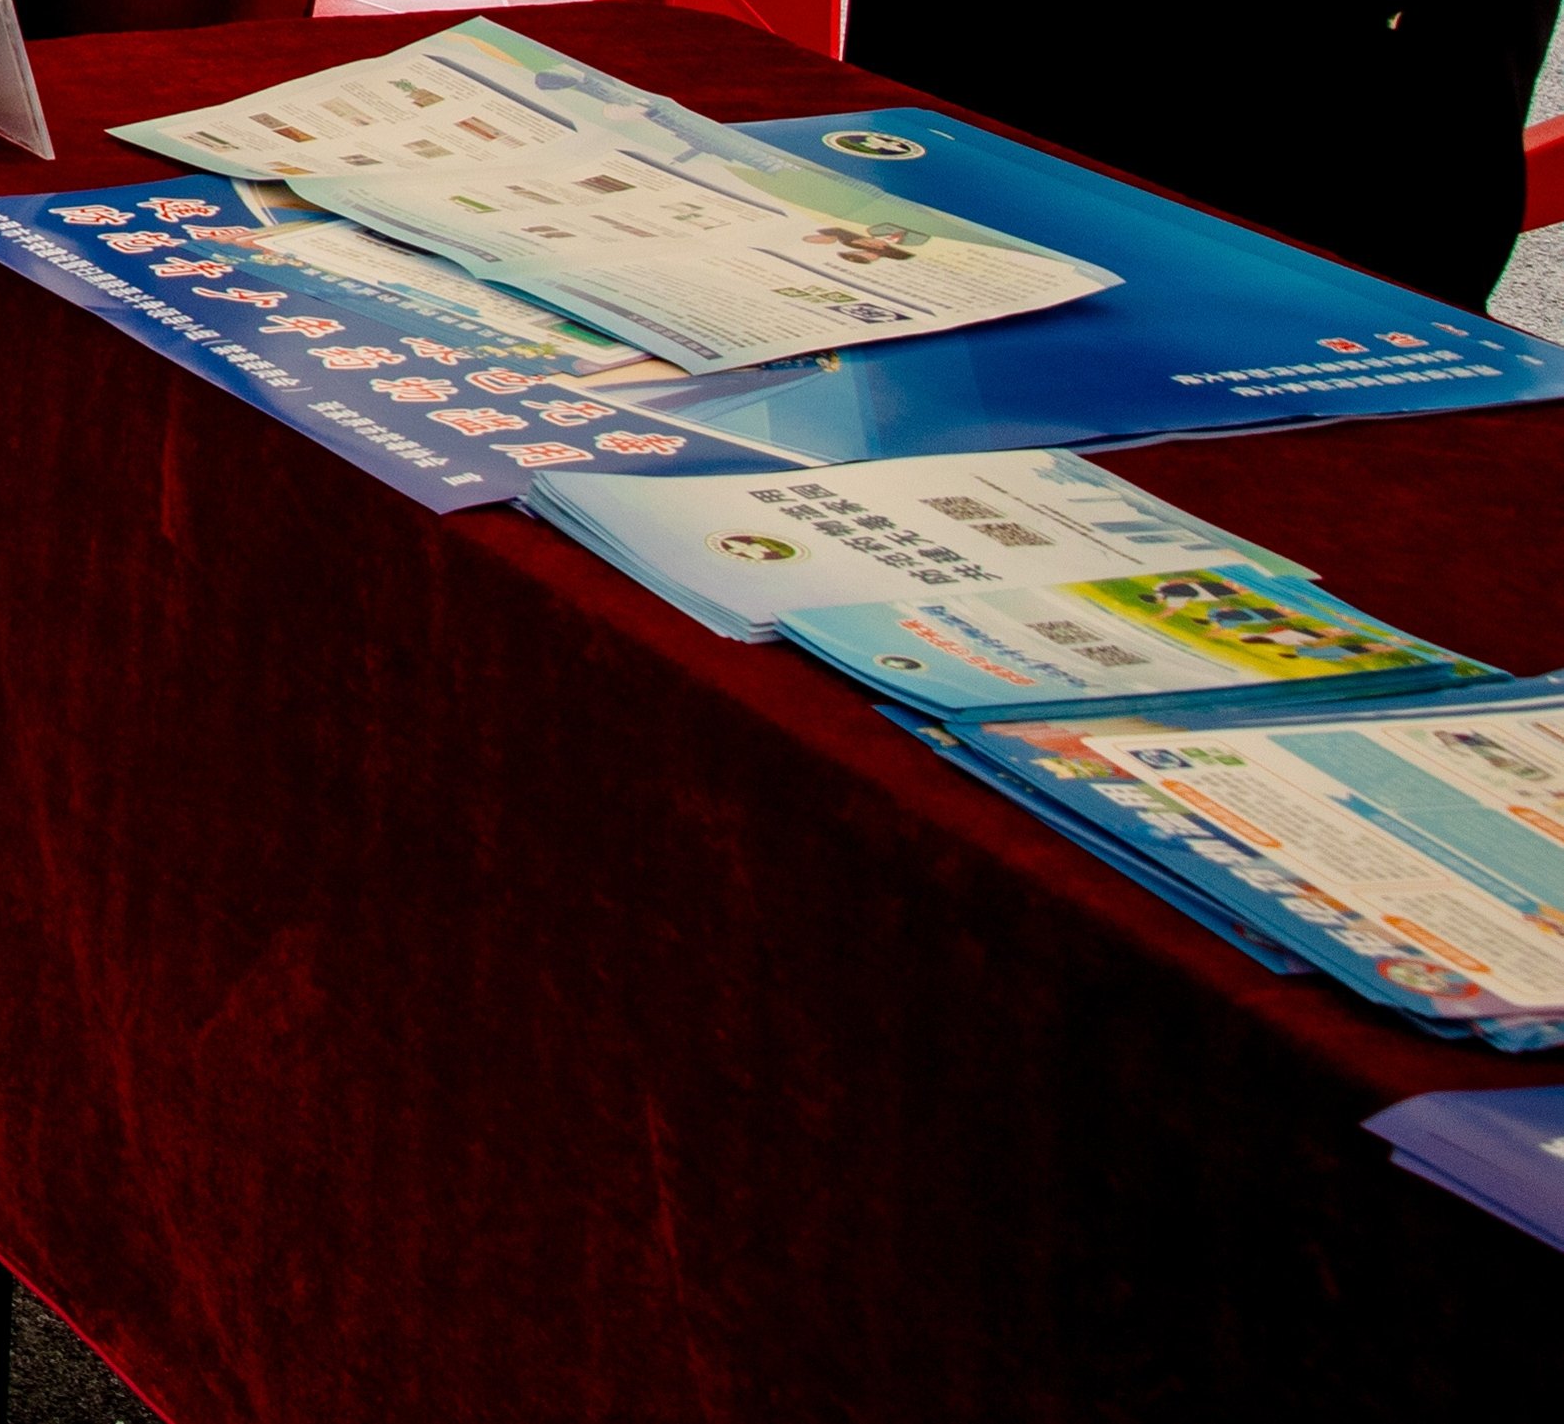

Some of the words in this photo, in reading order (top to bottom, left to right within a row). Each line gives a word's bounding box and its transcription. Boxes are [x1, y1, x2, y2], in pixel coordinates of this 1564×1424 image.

[49, 203, 596, 468] 防范青少年药物滥用
